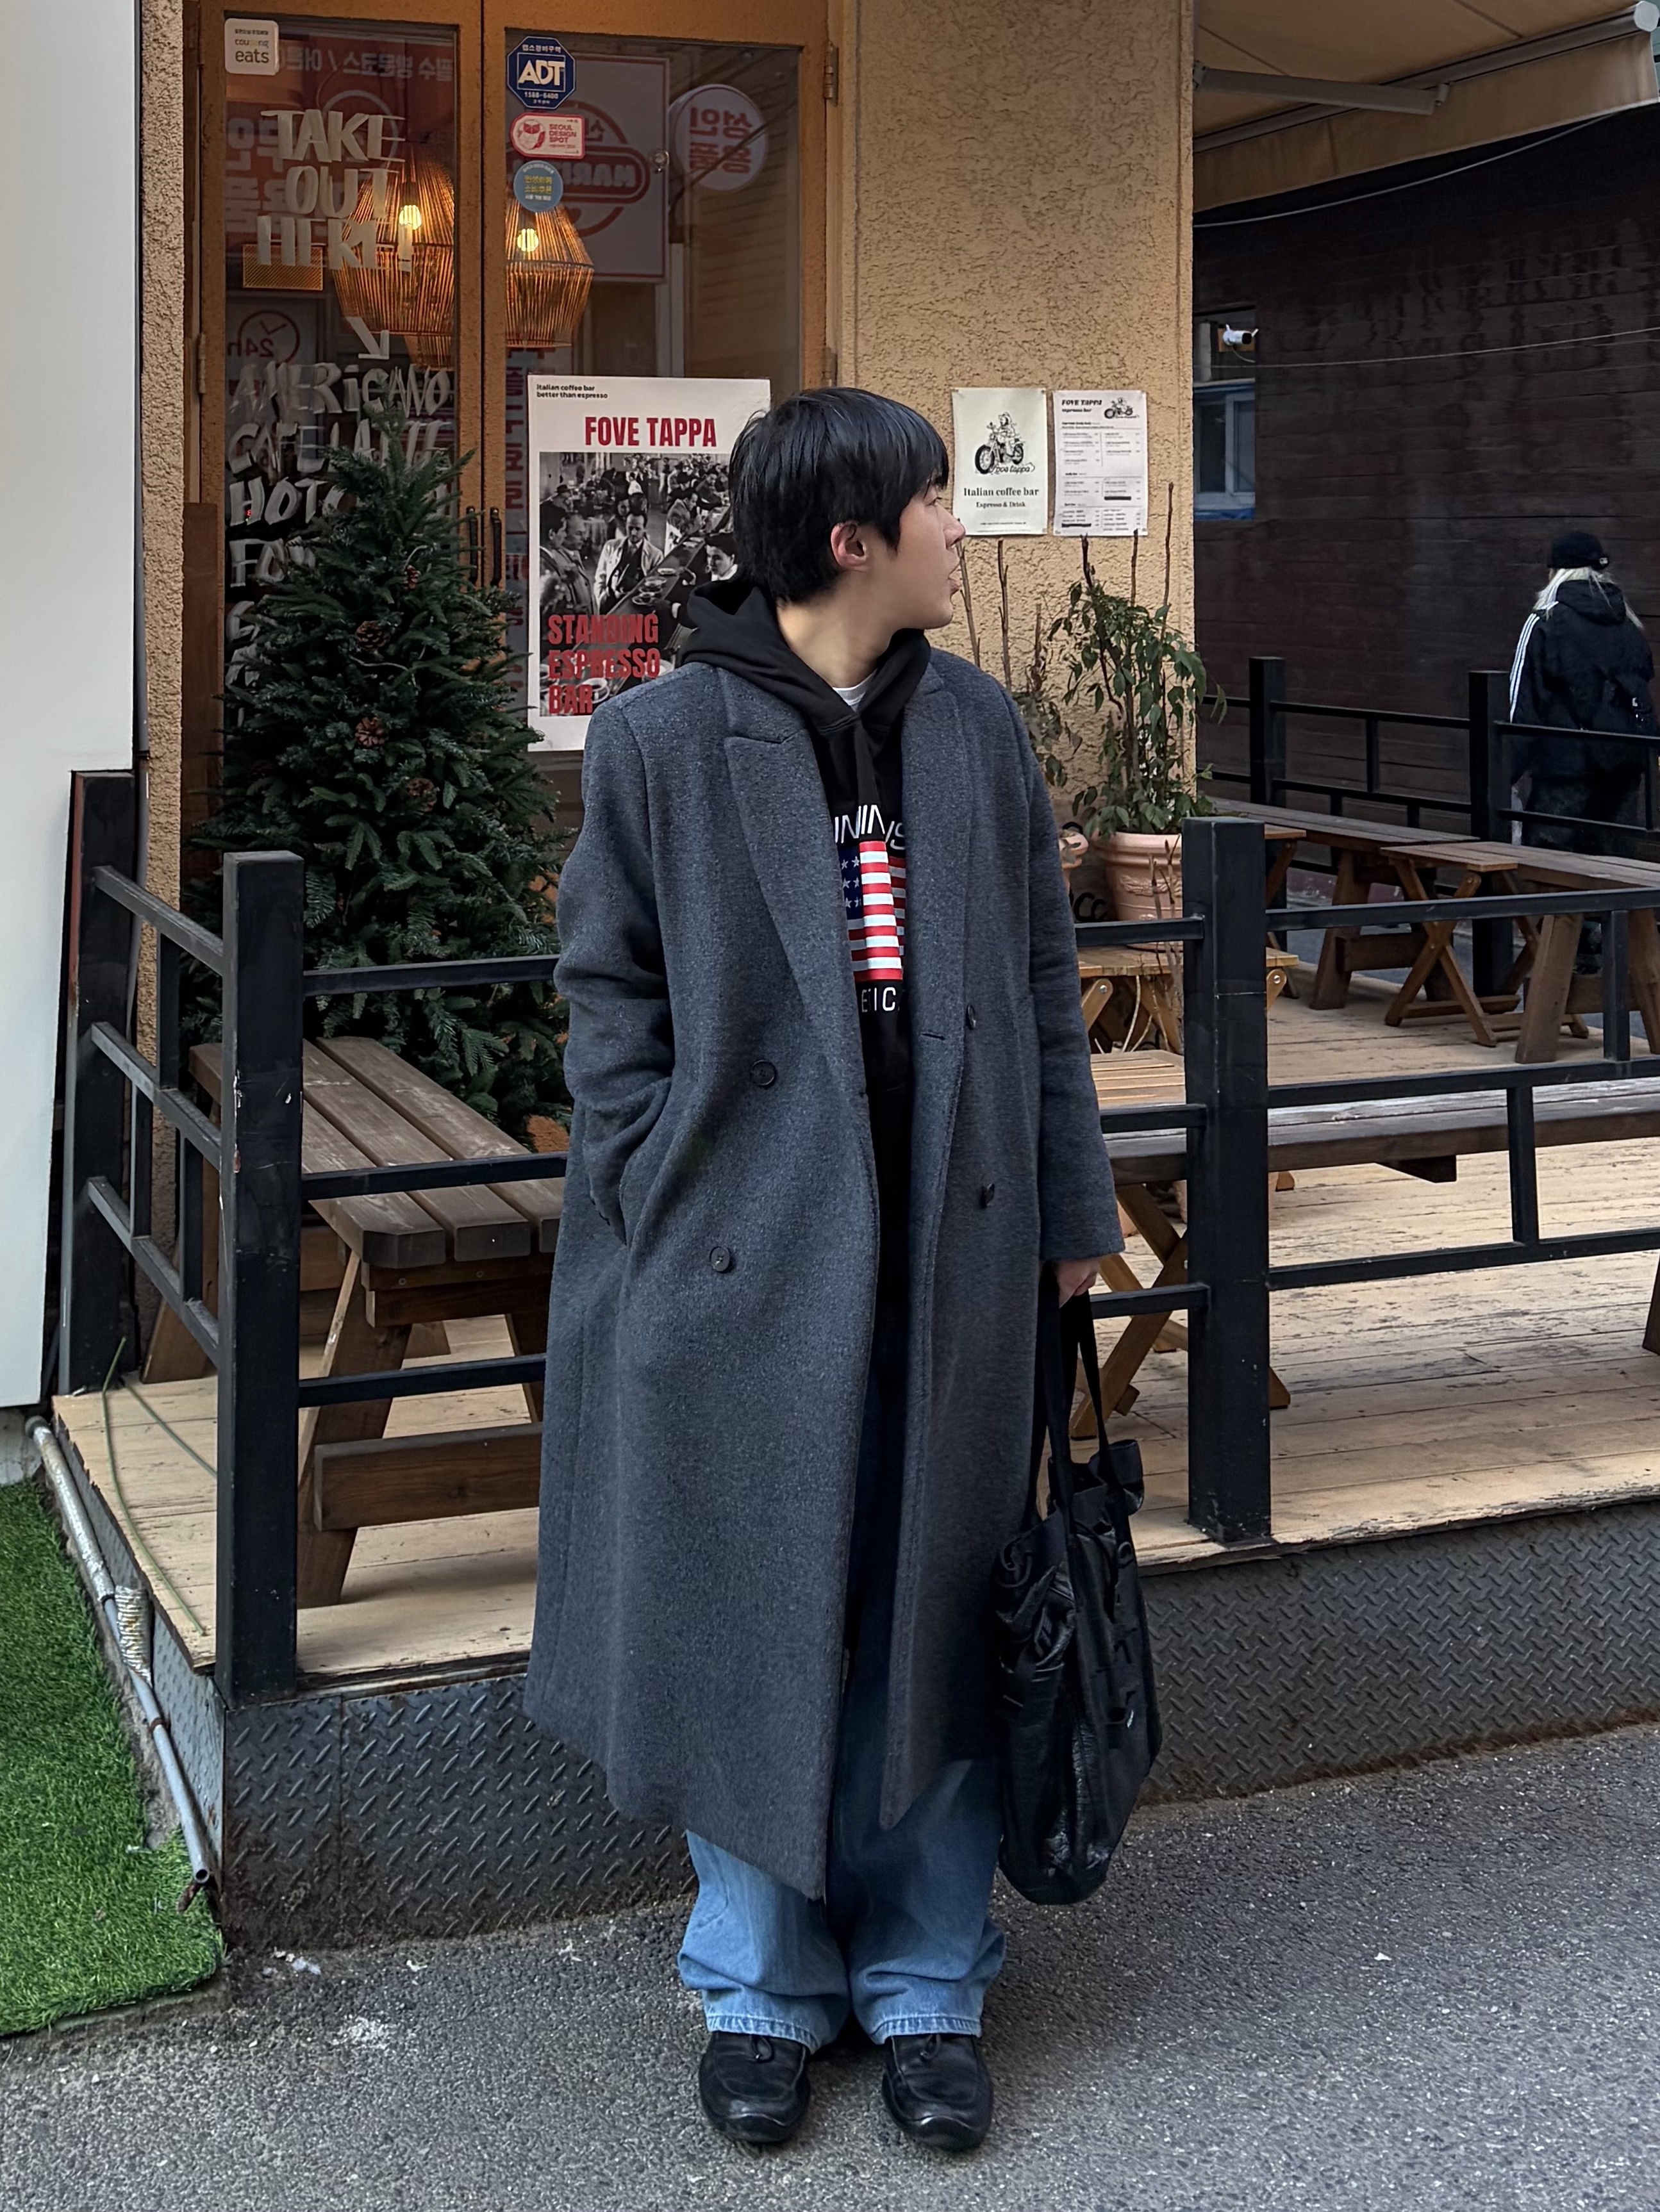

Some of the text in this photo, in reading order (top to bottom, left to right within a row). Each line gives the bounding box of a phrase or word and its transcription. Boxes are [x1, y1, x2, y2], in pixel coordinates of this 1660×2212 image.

[235, 49, 269, 63] eats
[518, 59, 565, 86] ADT
[260, 109, 406, 163] TAKE
[285, 165, 399, 219] OUT
[585, 417, 717, 447] FOVE TAPPA
[229, 476, 328, 526] HOT
[963, 487, 1040, 496] Italian coffee bar
[547, 613, 659, 645] STANDING
[547, 648, 660, 679] ESPRESSO
[548, 684, 593, 714] BAR
